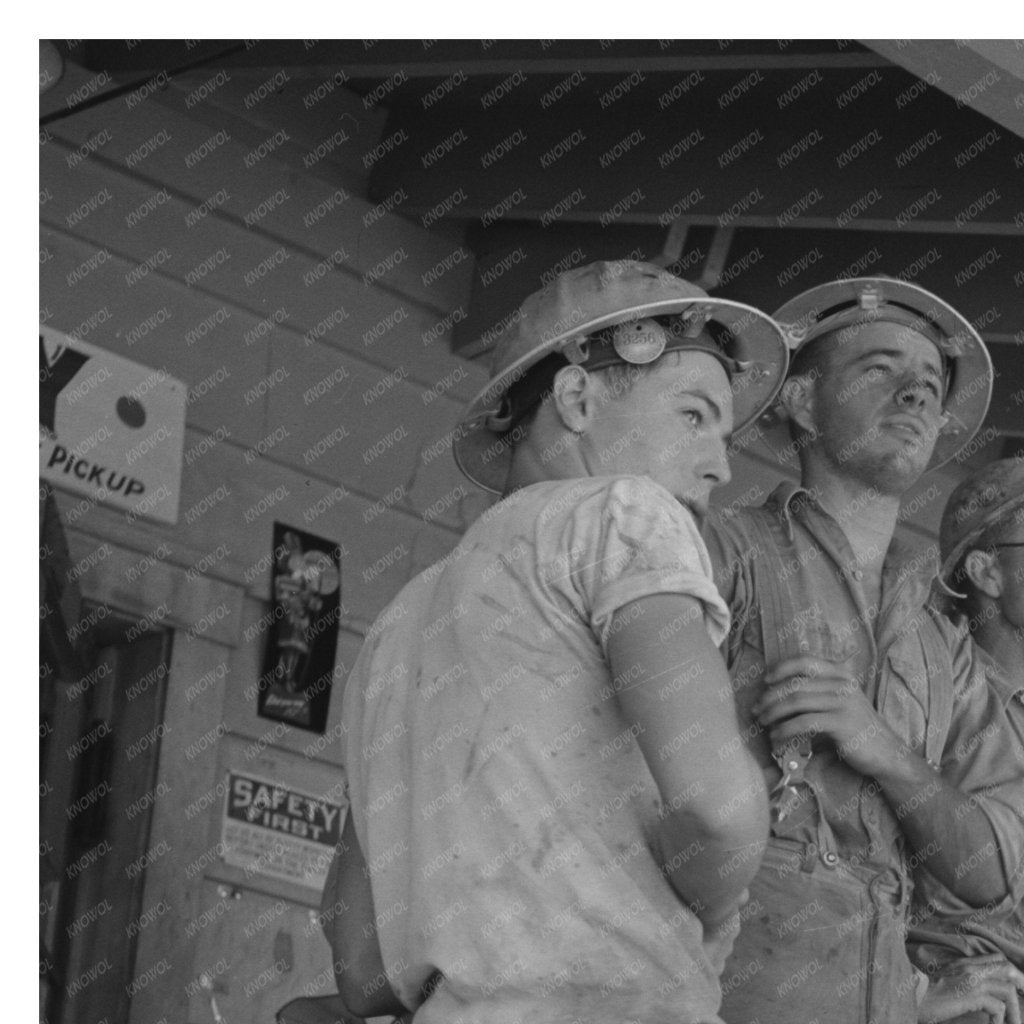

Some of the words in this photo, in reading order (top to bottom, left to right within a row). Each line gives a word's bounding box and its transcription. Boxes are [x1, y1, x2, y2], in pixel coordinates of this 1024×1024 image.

[47, 445, 145, 497] PICKUP
[233, 779, 338, 833] SAFETY
[248, 806, 323, 841] FIRST
